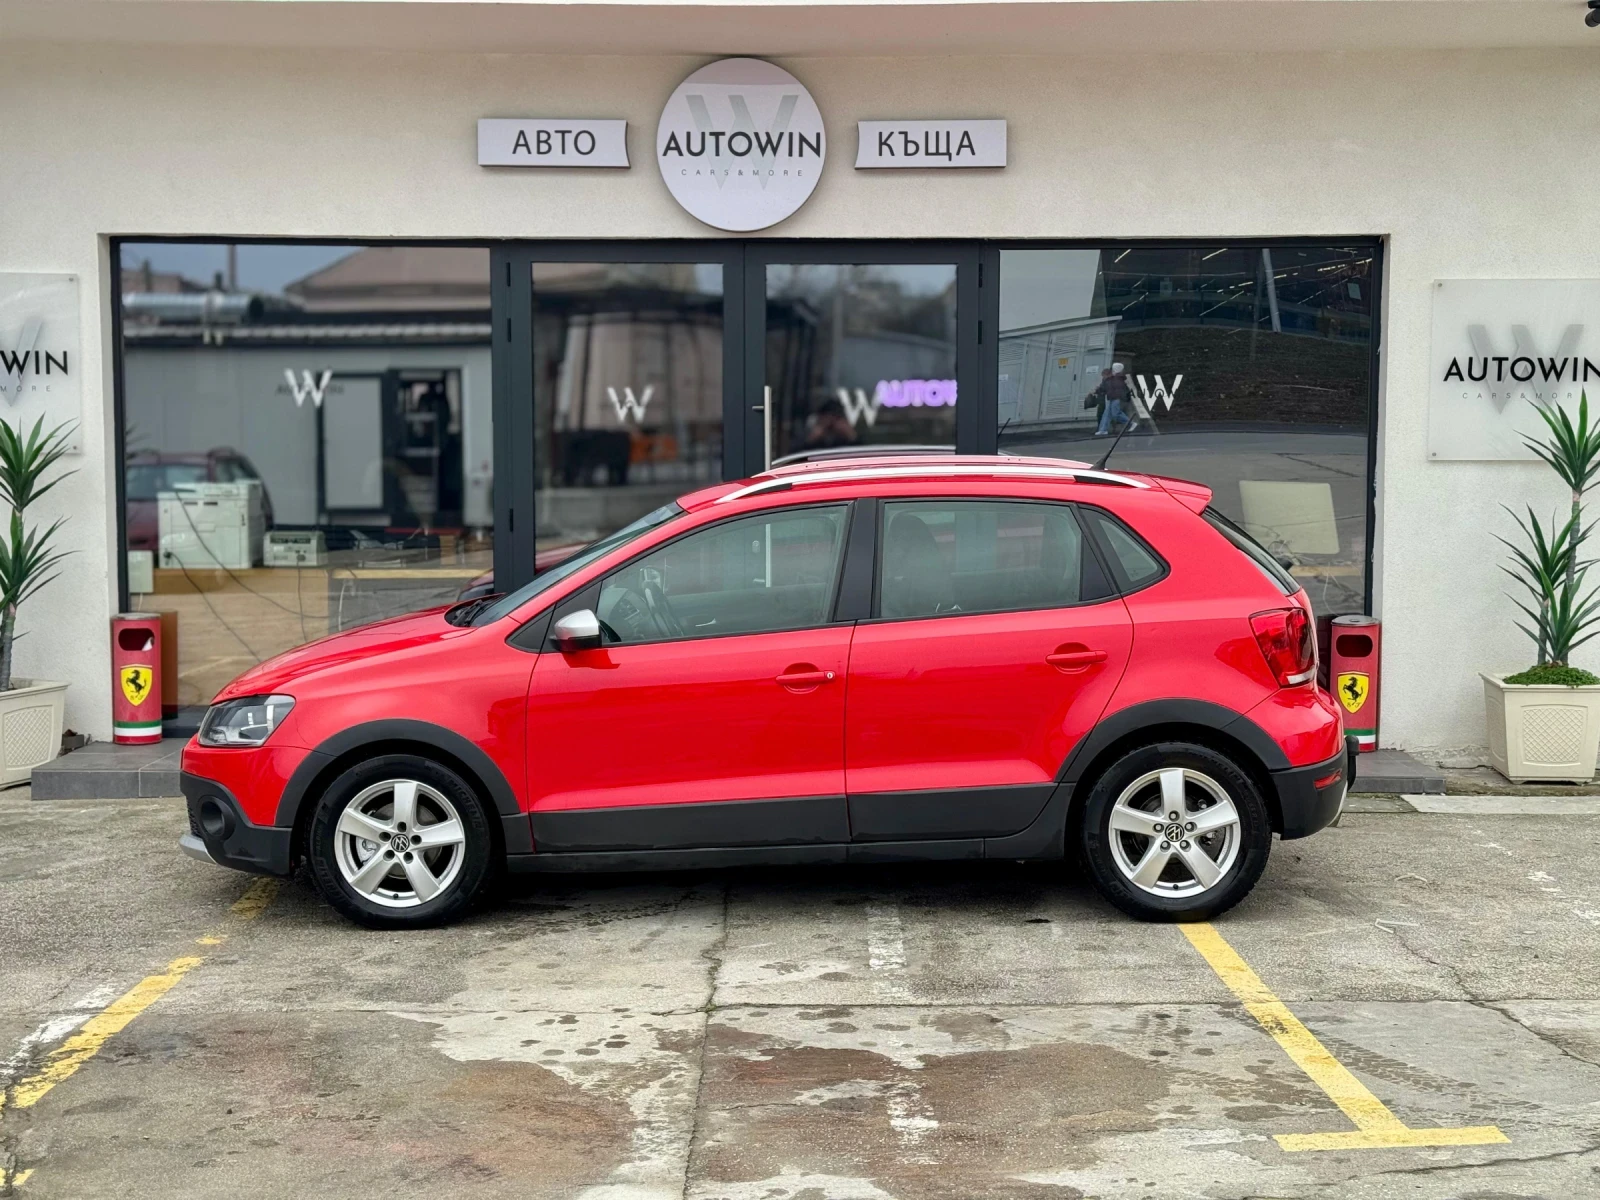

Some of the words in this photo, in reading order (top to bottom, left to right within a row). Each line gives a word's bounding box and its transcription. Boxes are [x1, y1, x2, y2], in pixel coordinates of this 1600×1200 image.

[511, 129, 597, 156] АВТО
[662, 130, 821, 158] AUTOWIN
[877, 130, 977, 160] КЪЩА
[1443, 356, 1600, 383] AUTOWIN
[284, 369, 333, 407] W
[608, 387, 654, 422] W
